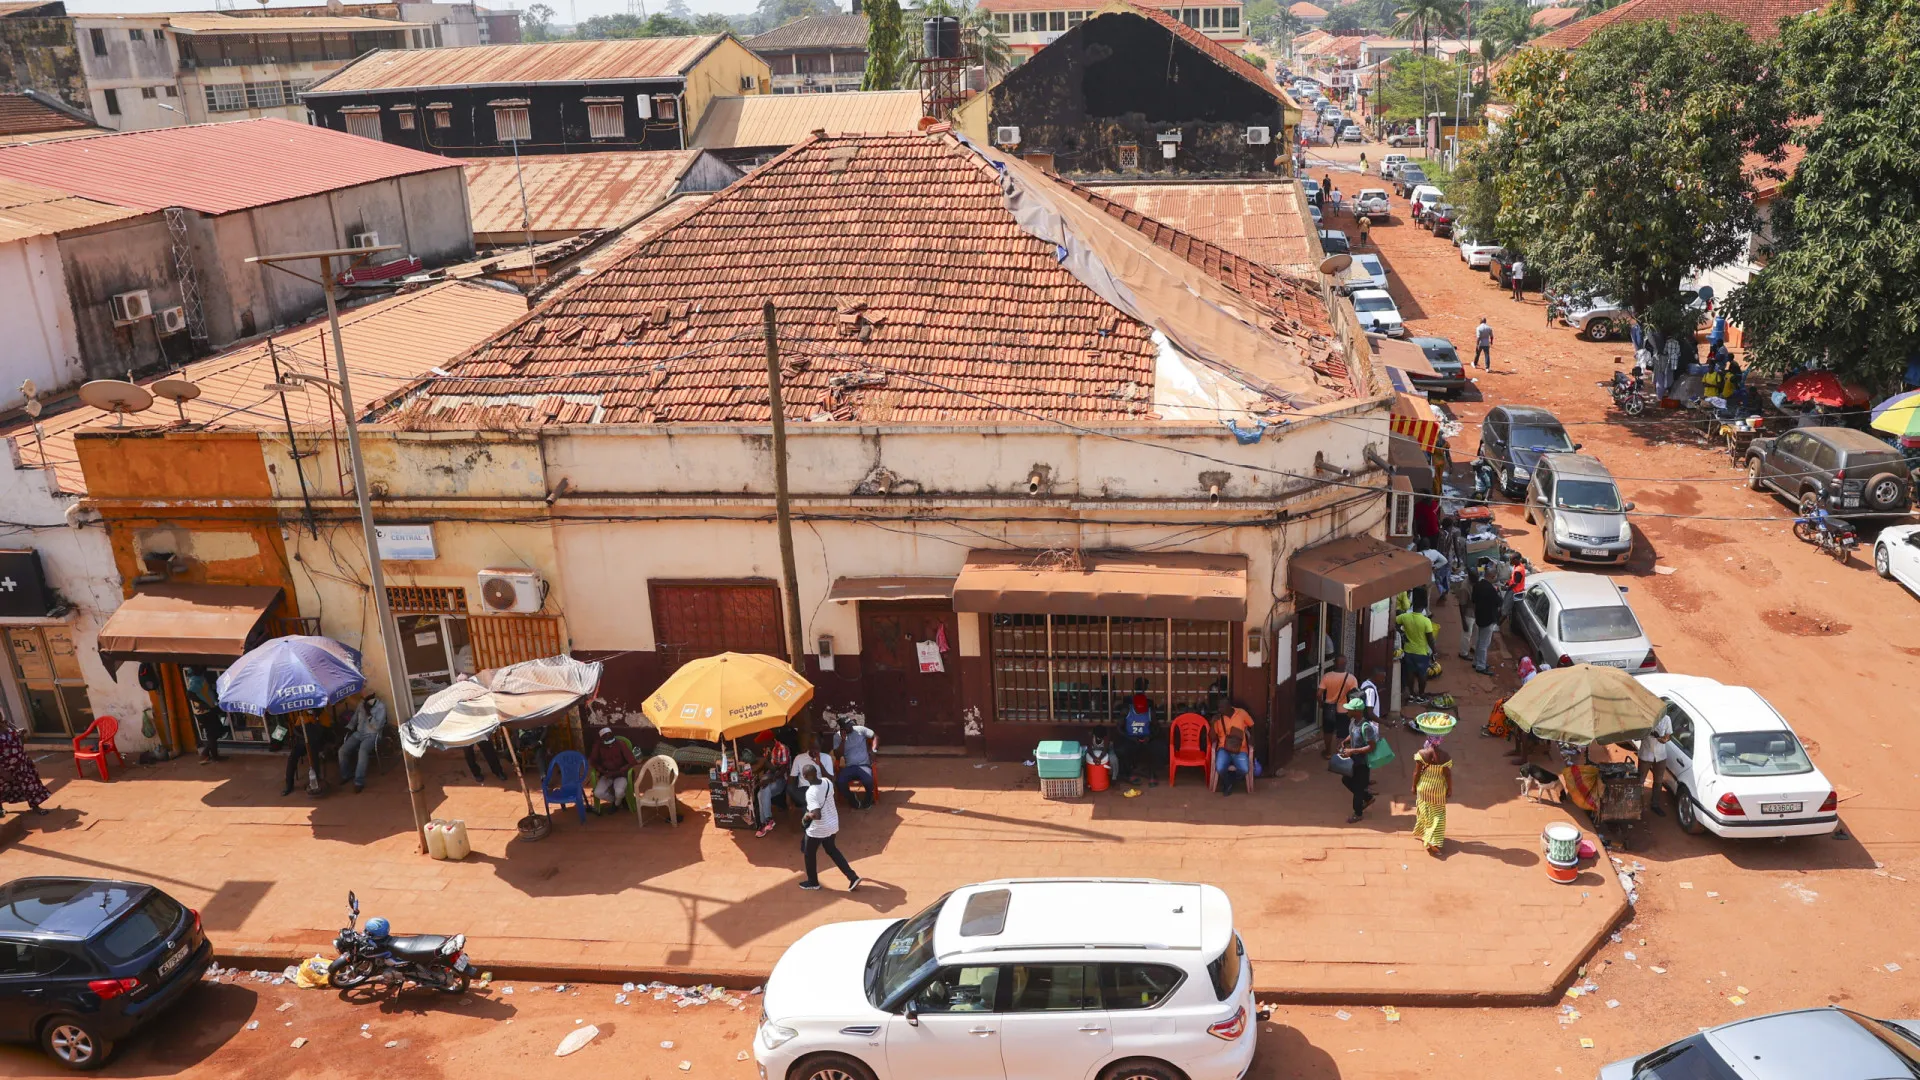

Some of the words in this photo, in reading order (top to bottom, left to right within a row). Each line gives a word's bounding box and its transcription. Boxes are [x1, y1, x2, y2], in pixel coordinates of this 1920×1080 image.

[276, 684, 316, 697] TECNO
[335, 684, 356, 699] TECNO
[280, 699, 314, 710] TECNO
[729, 706, 745, 716] Faci
[745, 702, 769, 712] MoMo
